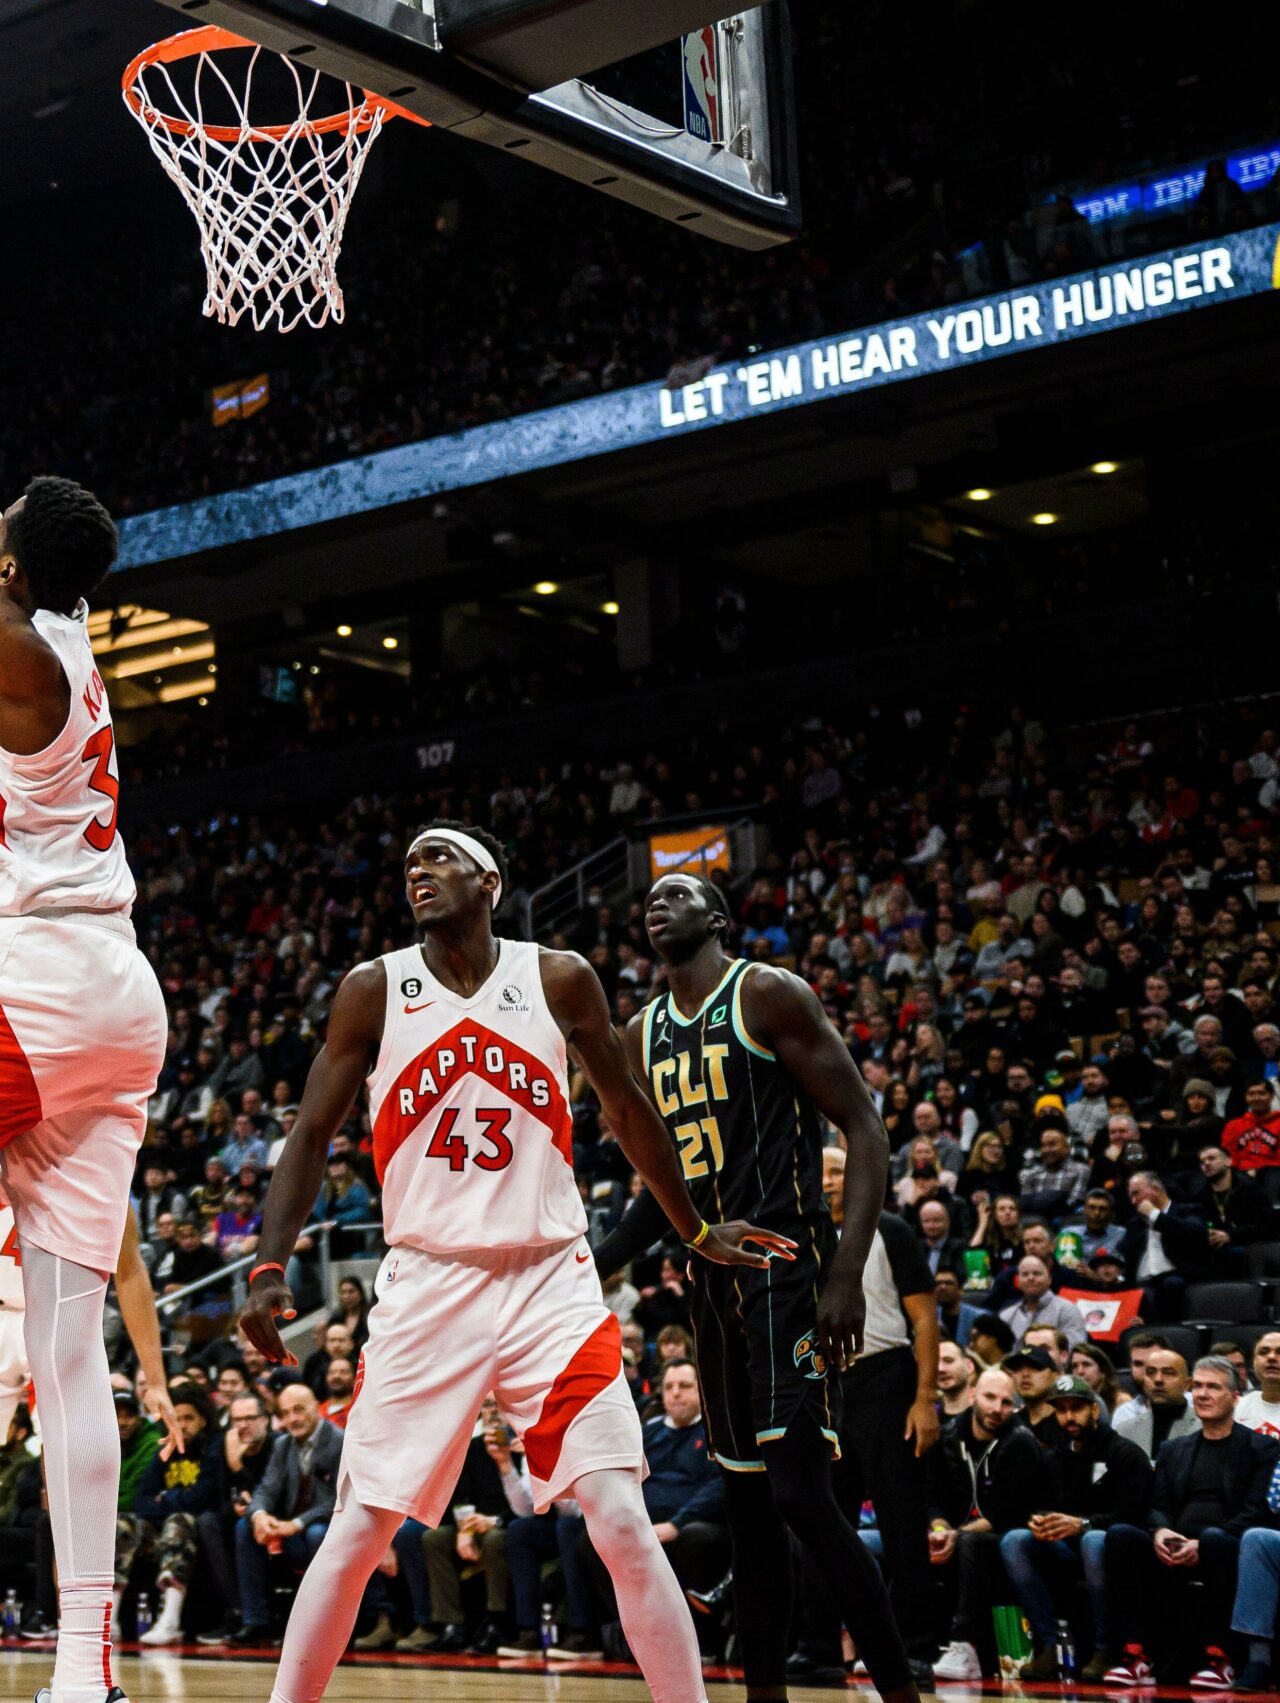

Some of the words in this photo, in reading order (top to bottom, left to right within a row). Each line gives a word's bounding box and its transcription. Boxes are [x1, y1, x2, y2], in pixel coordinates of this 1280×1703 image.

[689, 111, 706, 138] NBA
[1154, 169, 1207, 208] IBM
[659, 372, 729, 428] LET
[737, 354, 803, 406] 'EM
[811, 326, 919, 390] HEAR
[927, 295, 1043, 359] YOUR
[1052, 247, 1235, 331] HUNGER
[417, 741, 455, 768] 107
[405, 980, 418, 996] 6
[498, 1003, 514, 1012] Sun
[515, 1003, 531, 1012] Life
[656, 1009, 666, 1024] 6
[399, 1035, 550, 1116] RAPTORS
[651, 1043, 729, 1118] CLT
[425, 1107, 514, 1172] 43
[674, 1116, 725, 1181] 21
